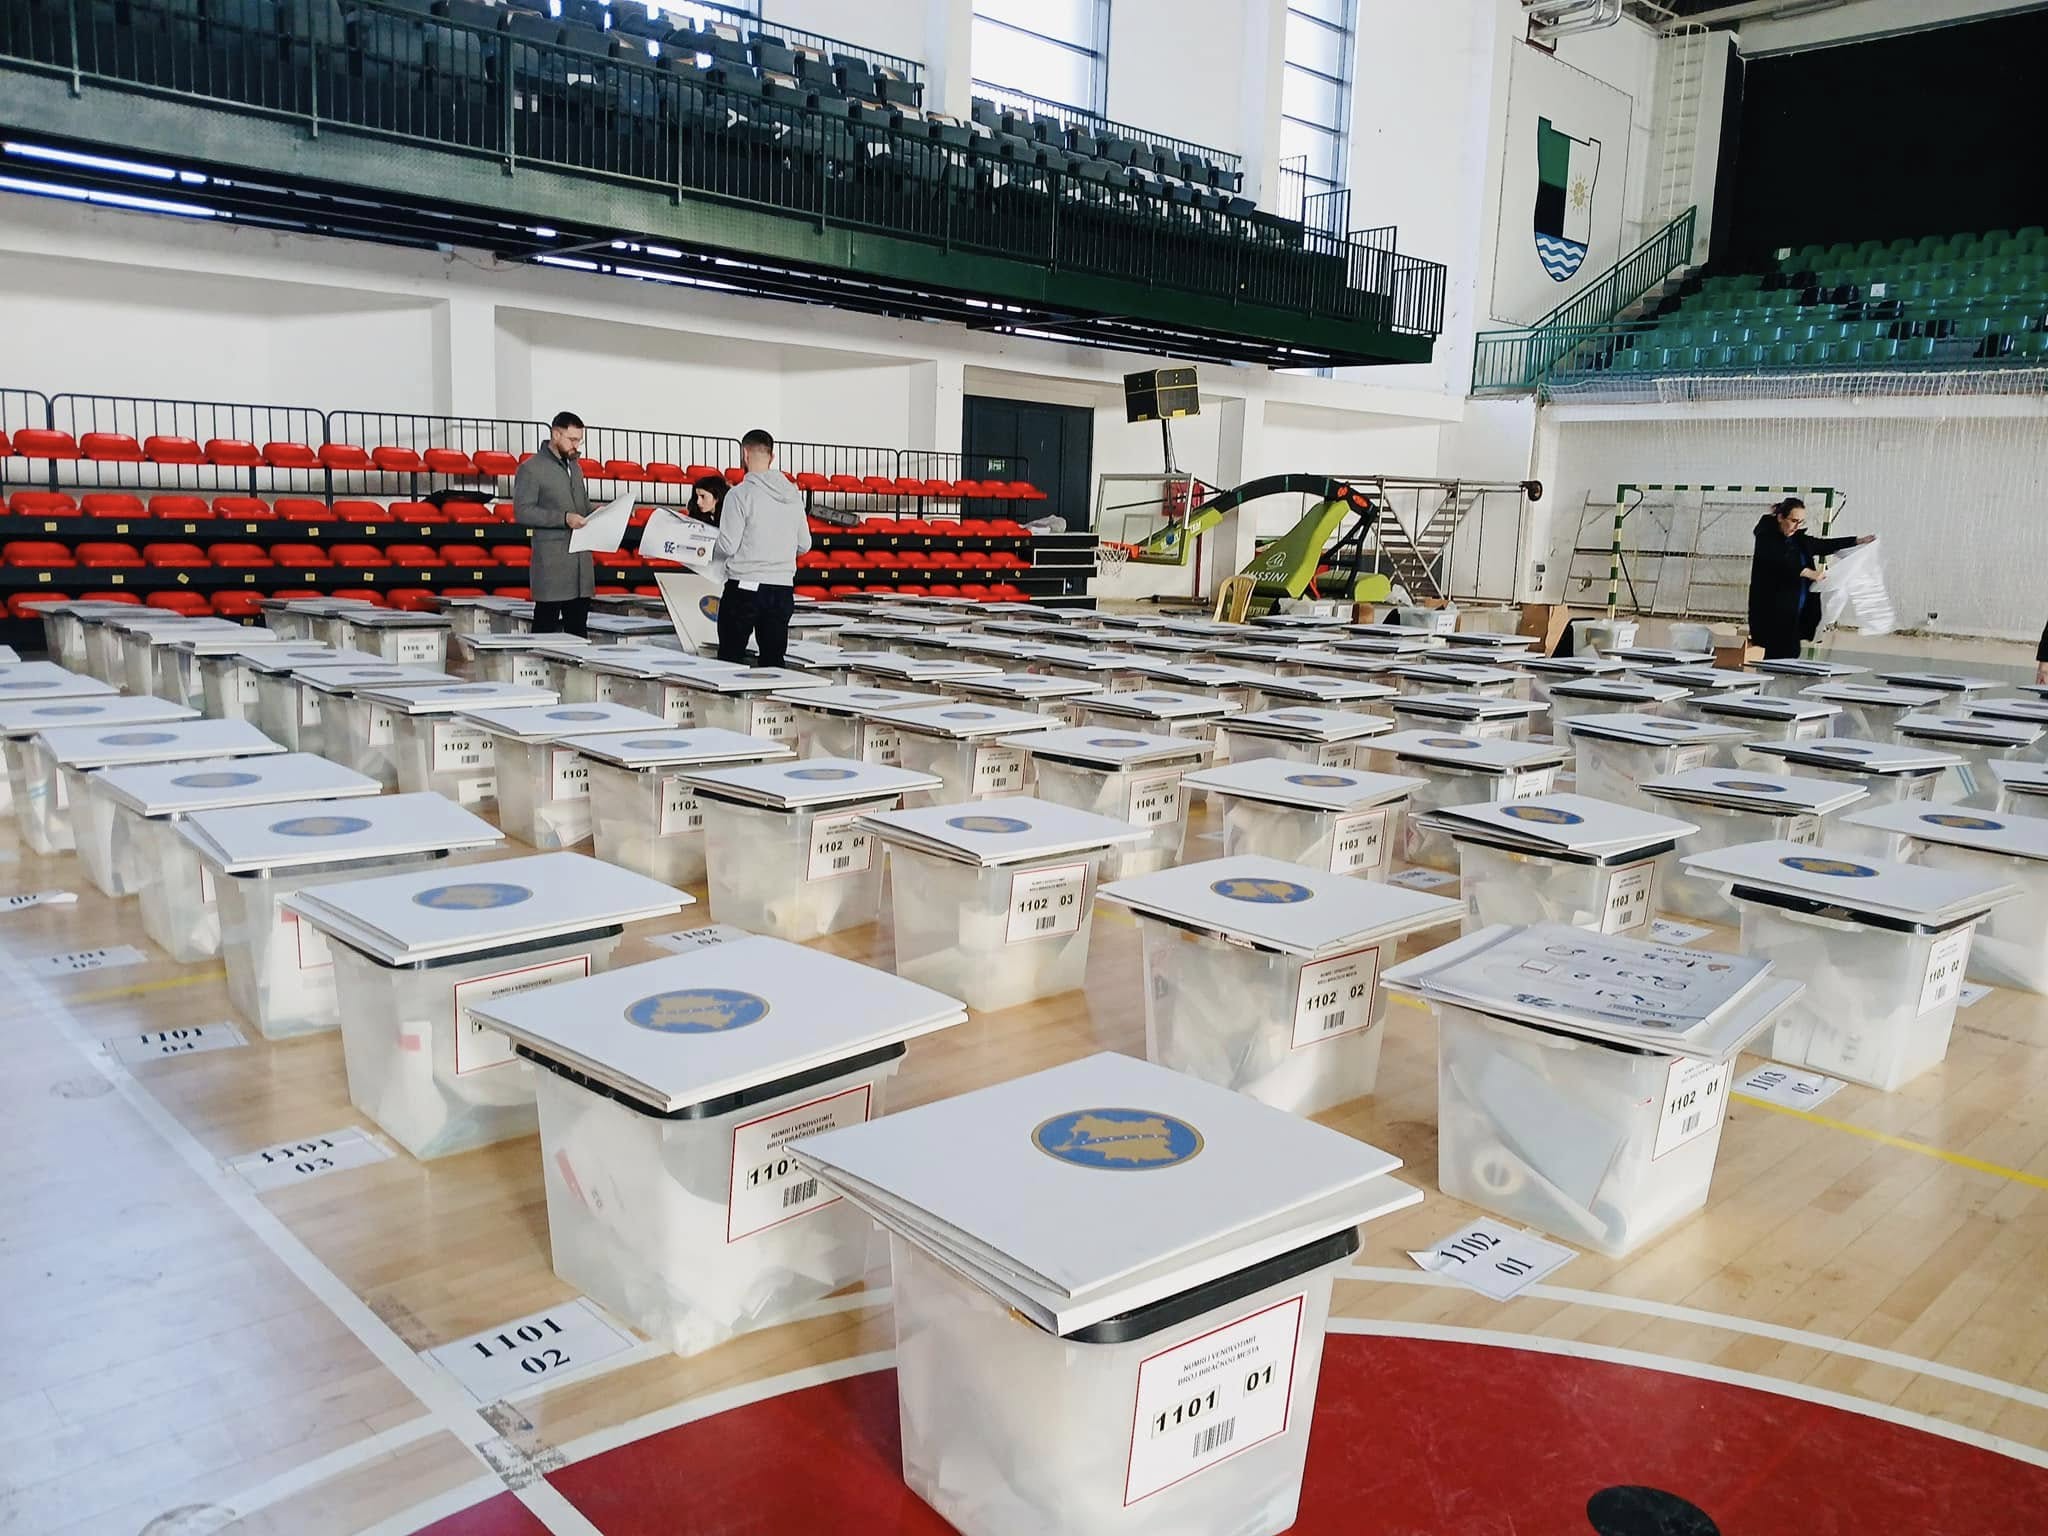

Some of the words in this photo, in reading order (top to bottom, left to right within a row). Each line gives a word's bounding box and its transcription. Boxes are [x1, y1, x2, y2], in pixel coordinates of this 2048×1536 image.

[443, 742, 470, 751] 1102
[870, 738, 889, 749] 1104
[563, 768, 589, 779] 1102
[819, 840, 843, 854] 1102
[853, 836, 865, 848] 04
[1340, 838, 1359, 851] 1103
[1019, 897, 1048, 913] 1102
[1060, 894, 1073, 906] 03
[1306, 991, 1338, 1011] 1102
[1350, 983, 1365, 999] 02
[1670, 1090, 1697, 1114] 1102
[1706, 1078, 1719, 1096] 01
[262, 1139, 334, 1163] 1101
[295, 1157, 334, 1174] 03
[1440, 1232, 1502, 1265] 1102
[1494, 1256, 1535, 1277] 01
[471, 1317, 564, 1359] 1101
[520, 1348, 571, 1375] 02
[1155, 1389, 1216, 1433] 1101
[1246, 1365, 1273, 1392] 01
